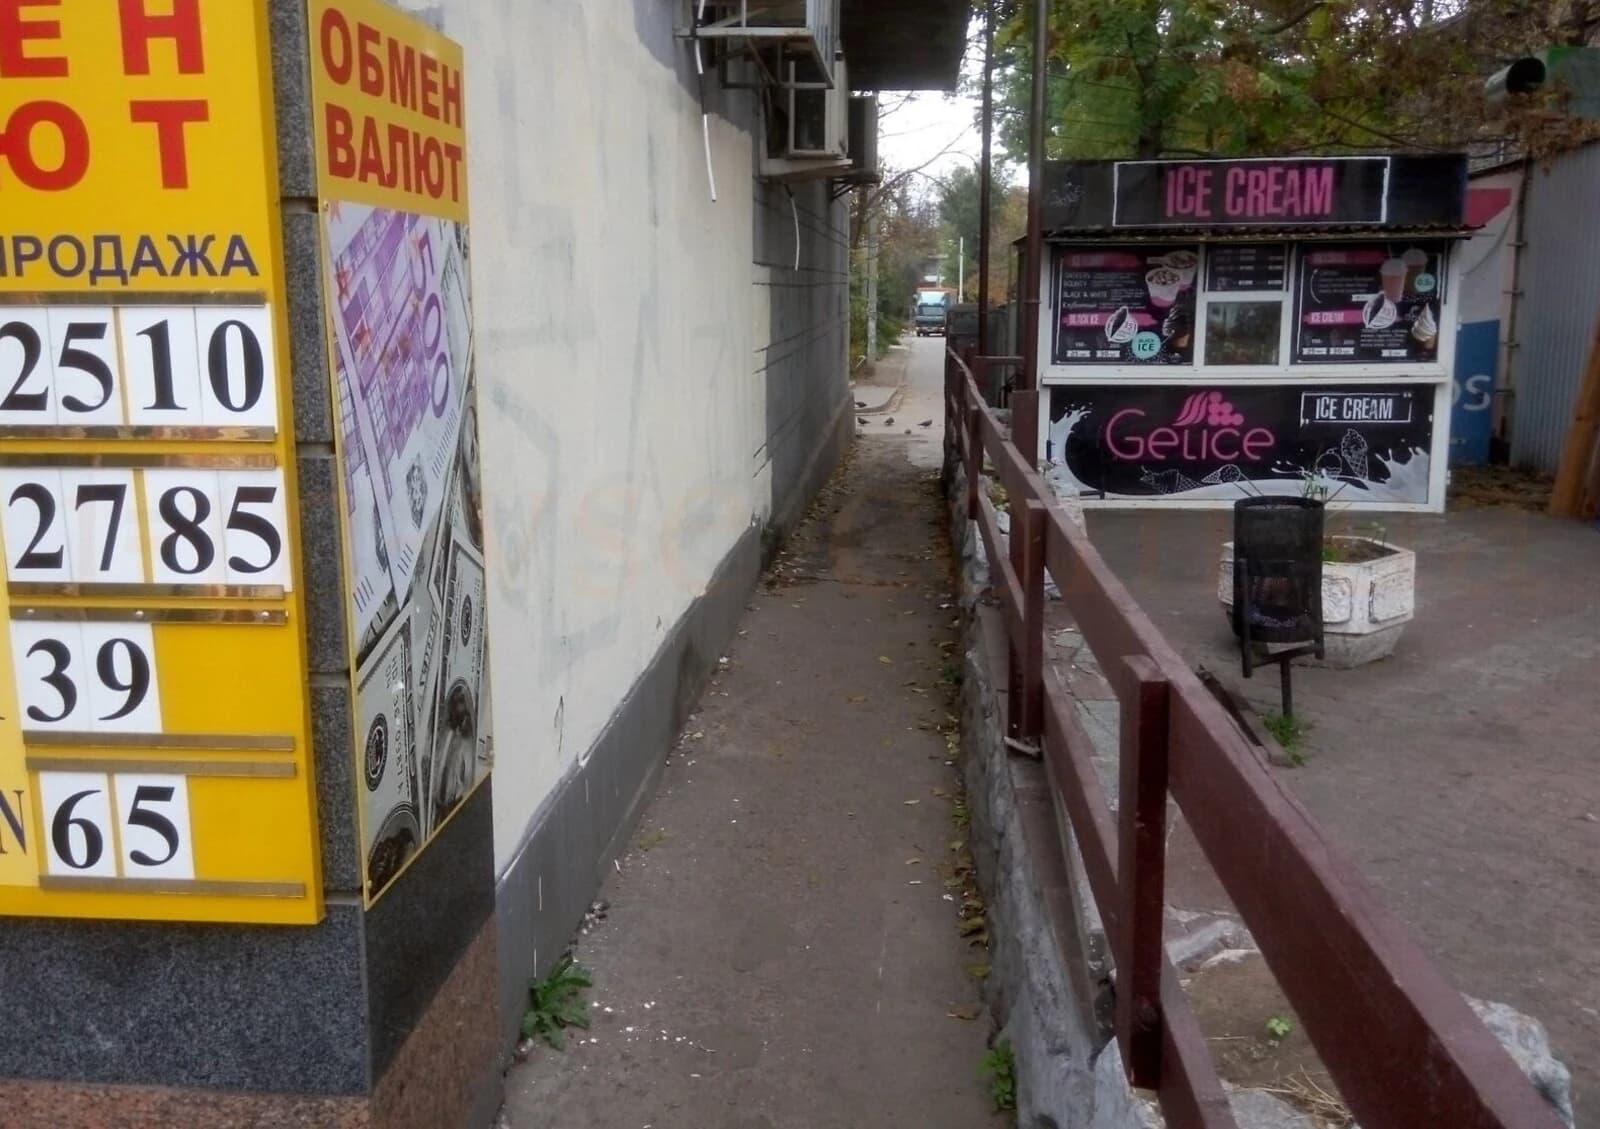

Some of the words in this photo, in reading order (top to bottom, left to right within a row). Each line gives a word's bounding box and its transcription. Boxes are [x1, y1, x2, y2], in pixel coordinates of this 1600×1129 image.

[319, 8, 463, 128] ОБМЕН
[325, 103, 463, 202] ВАЛЮТ
[1166, 166, 1213, 217] ICE
[1225, 166, 1335, 217] CREAM
[1138, 343, 1155, 352] ICE
[1315, 396, 1338, 420] ICE
[1343, 397, 1393, 420] CREAM
[26, 638, 150, 722] 39
[51, 786, 179, 869] 65
